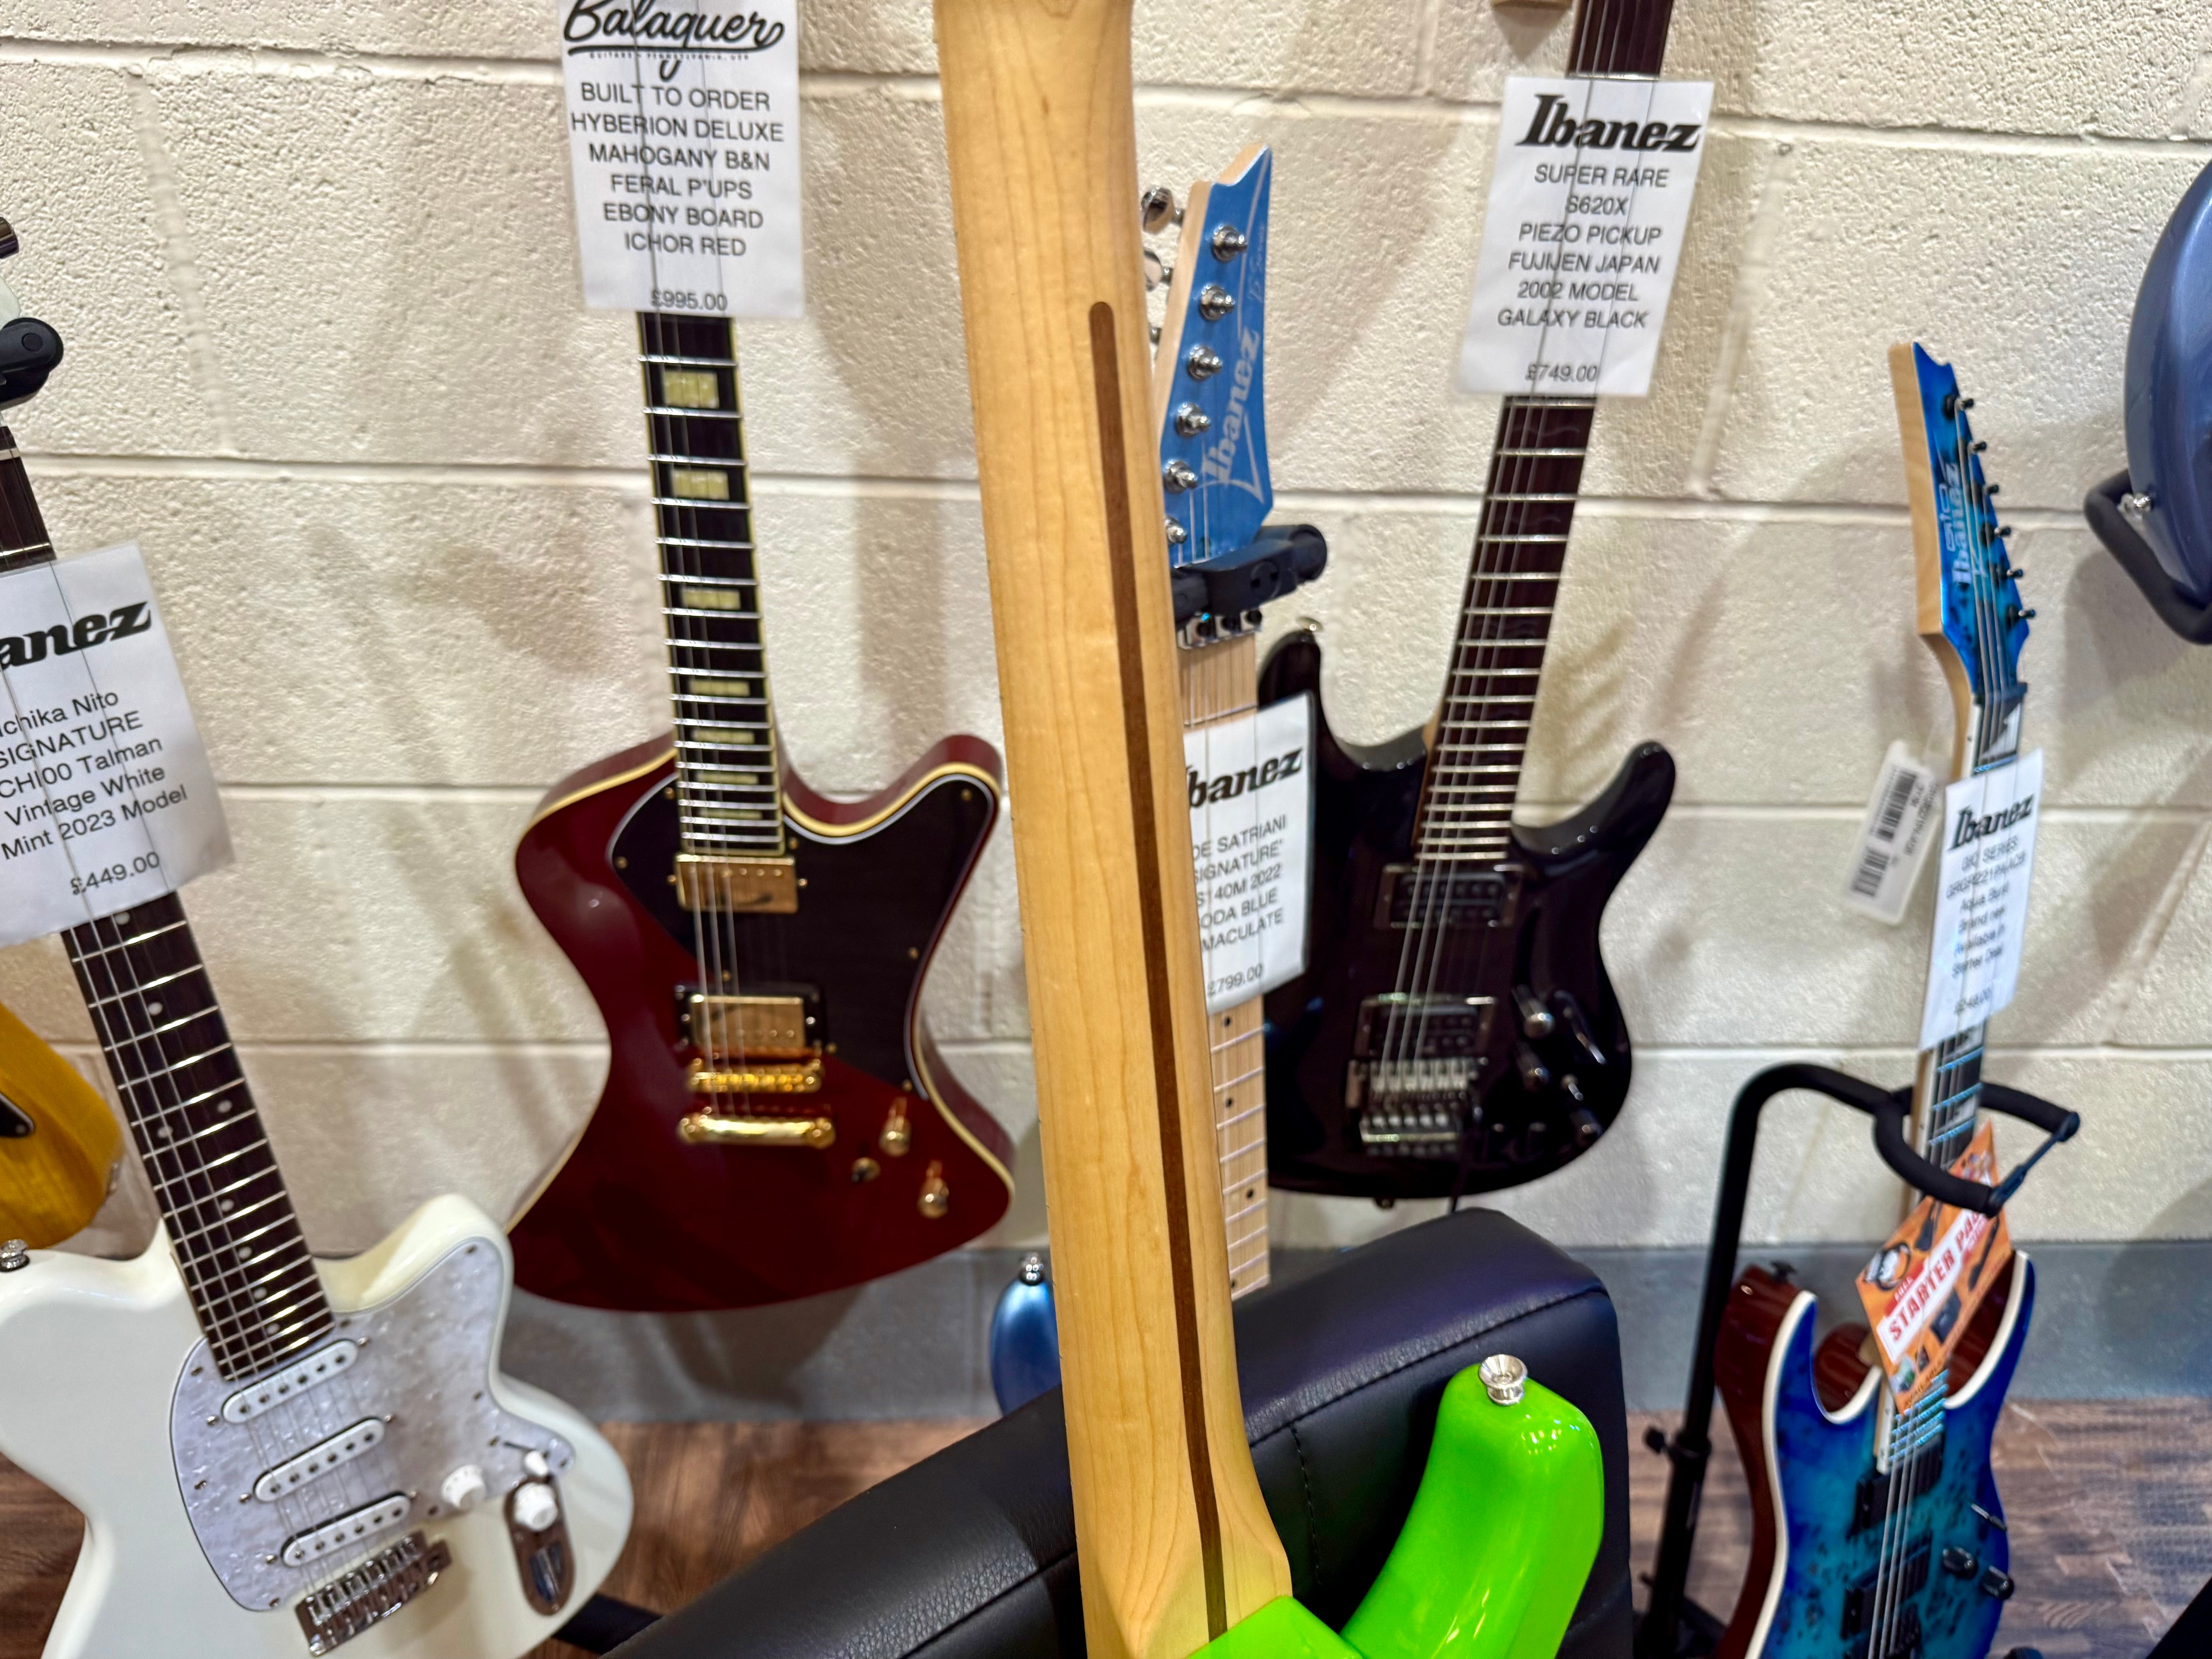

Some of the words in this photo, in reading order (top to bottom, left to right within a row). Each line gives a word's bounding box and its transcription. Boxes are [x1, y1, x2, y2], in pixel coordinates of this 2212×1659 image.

[564, 0, 784, 82] Balaguer
[581, 82, 645, 104] BUILT
[652, 86, 682, 106] TO
[689, 88, 770, 111] ORDER
[572, 112, 687, 138] HYBERION
[694, 118, 784, 143] DELUXE
[1515, 93, 1703, 153] Ibanez
[589, 143, 717, 168] MAHOGANY
[725, 150, 770, 171] B&N
[611, 174, 682, 196] FERAL
[688, 177, 752, 200] P'UPS
[1534, 163, 1607, 186] SUPER
[1613, 165, 1670, 188] RARE
[603, 202, 678, 225] EBONY
[686, 207, 764, 229] BOARD
[1566, 194, 1630, 216] S620X
[624, 232, 694, 254] ICHOR
[700, 236, 747, 256] RED
[1518, 222, 1581, 243] PIEZO
[1586, 224, 1662, 245] PICKUP
[1595, 254, 1661, 273] JAPAN
[651, 289, 728, 311] £995.00
[1517, 280, 1564, 299] 2002
[1568, 282, 1639, 301] MODEL
[1497, 308, 1582, 328] GALAXY
[1583, 309, 1650, 329] BLACK
[1525, 363, 1599, 383] £749.00
[1202, 328, 1259, 483] Ibanez
[0, 707, 68, 736] chika
[72, 692, 118, 716] Nito
[76, 738, 163, 774] Talman
[1186, 747, 1303, 808] banez
[4, 790, 96, 826] Vintage
[100, 767, 165, 797] White
[1, 830, 54, 860] Mint
[58, 809, 116, 840] 2023
[121, 784, 187, 821] Model
[1217, 814, 1286, 853] SATRIANI
[1947, 793, 2034, 851] Ibanez
[70, 851, 160, 895] £449.00
[1250, 863, 1281, 890] 2022
[1199, 906, 1237, 929] ODA
[1241, 887, 1278, 917] BLUE
[1207, 963, 1264, 997] £799.00
[1889, 1247, 1955, 1341] STARTER
